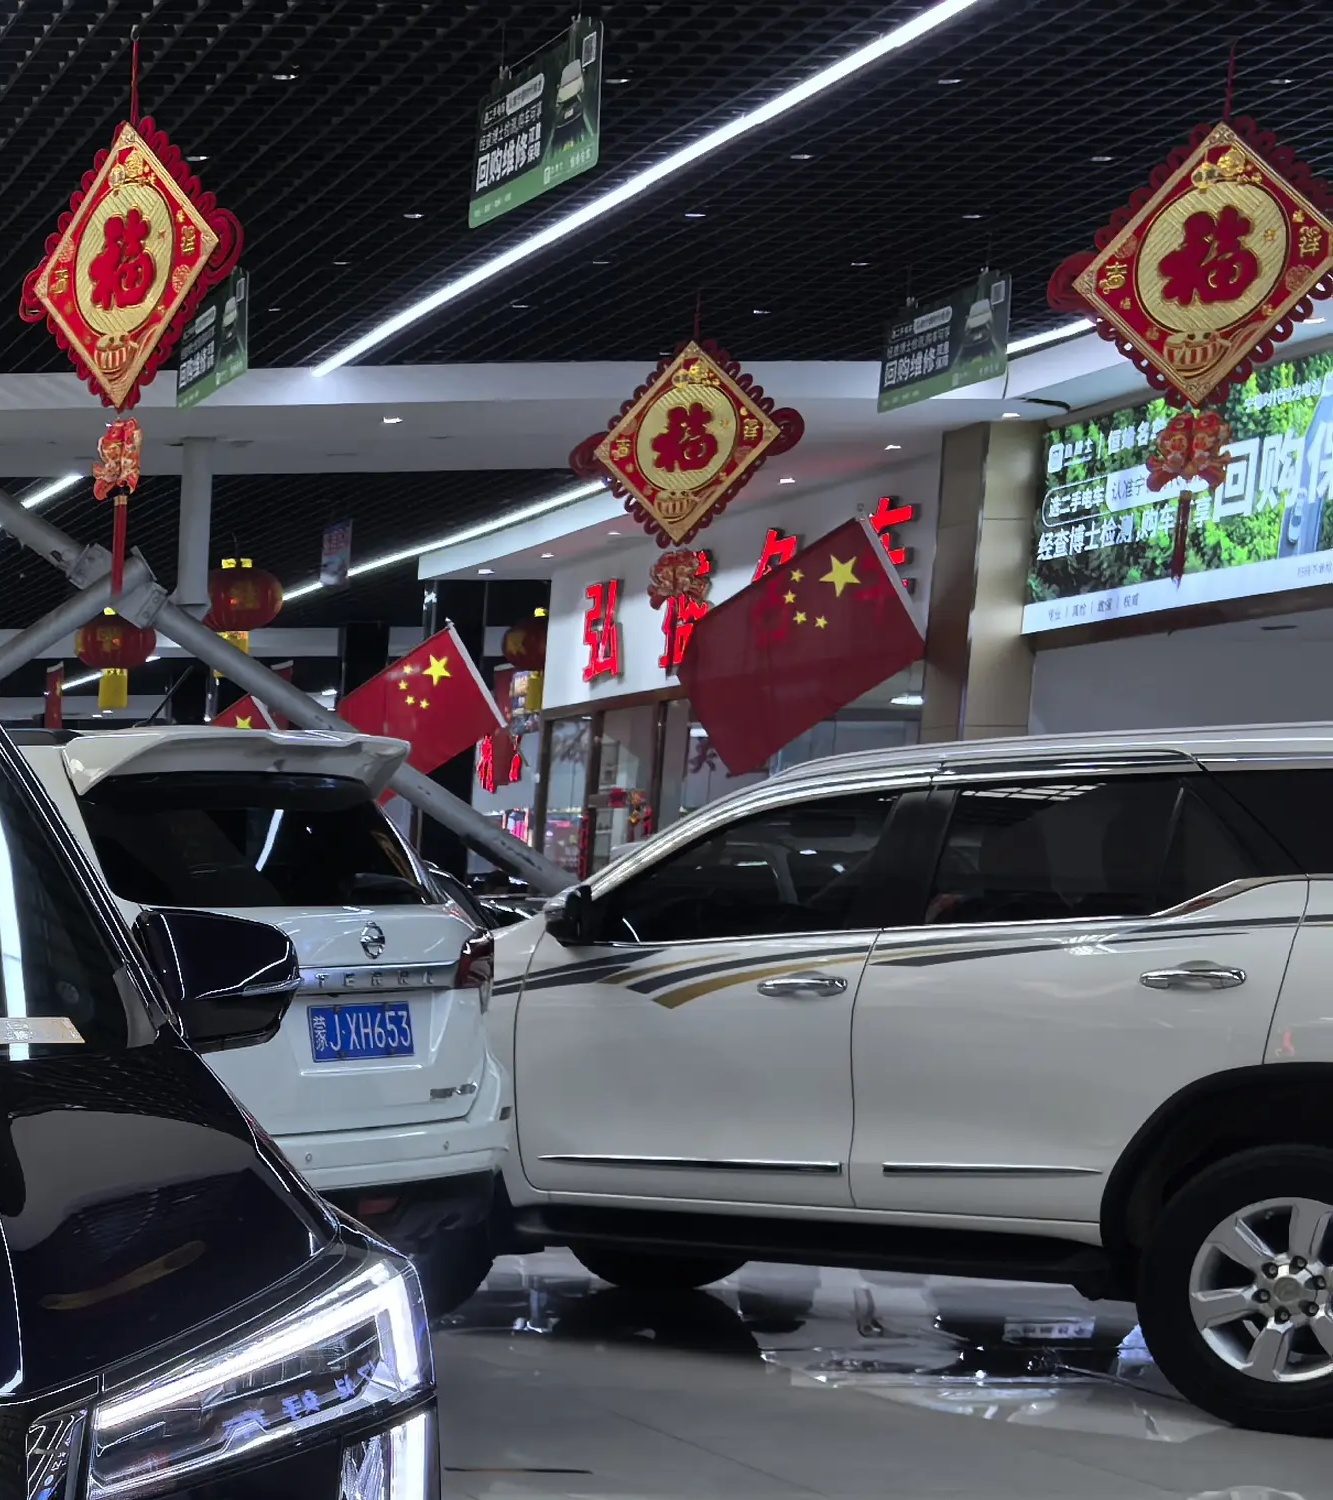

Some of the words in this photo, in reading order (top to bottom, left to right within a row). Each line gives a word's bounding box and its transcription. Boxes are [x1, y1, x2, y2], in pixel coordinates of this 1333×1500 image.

[89, 206, 155, 310] 福
[1158, 204, 1260, 306] 福
[652, 402, 719, 473] 福
[1037, 494, 1214, 561] 经查博士检测,购车享
